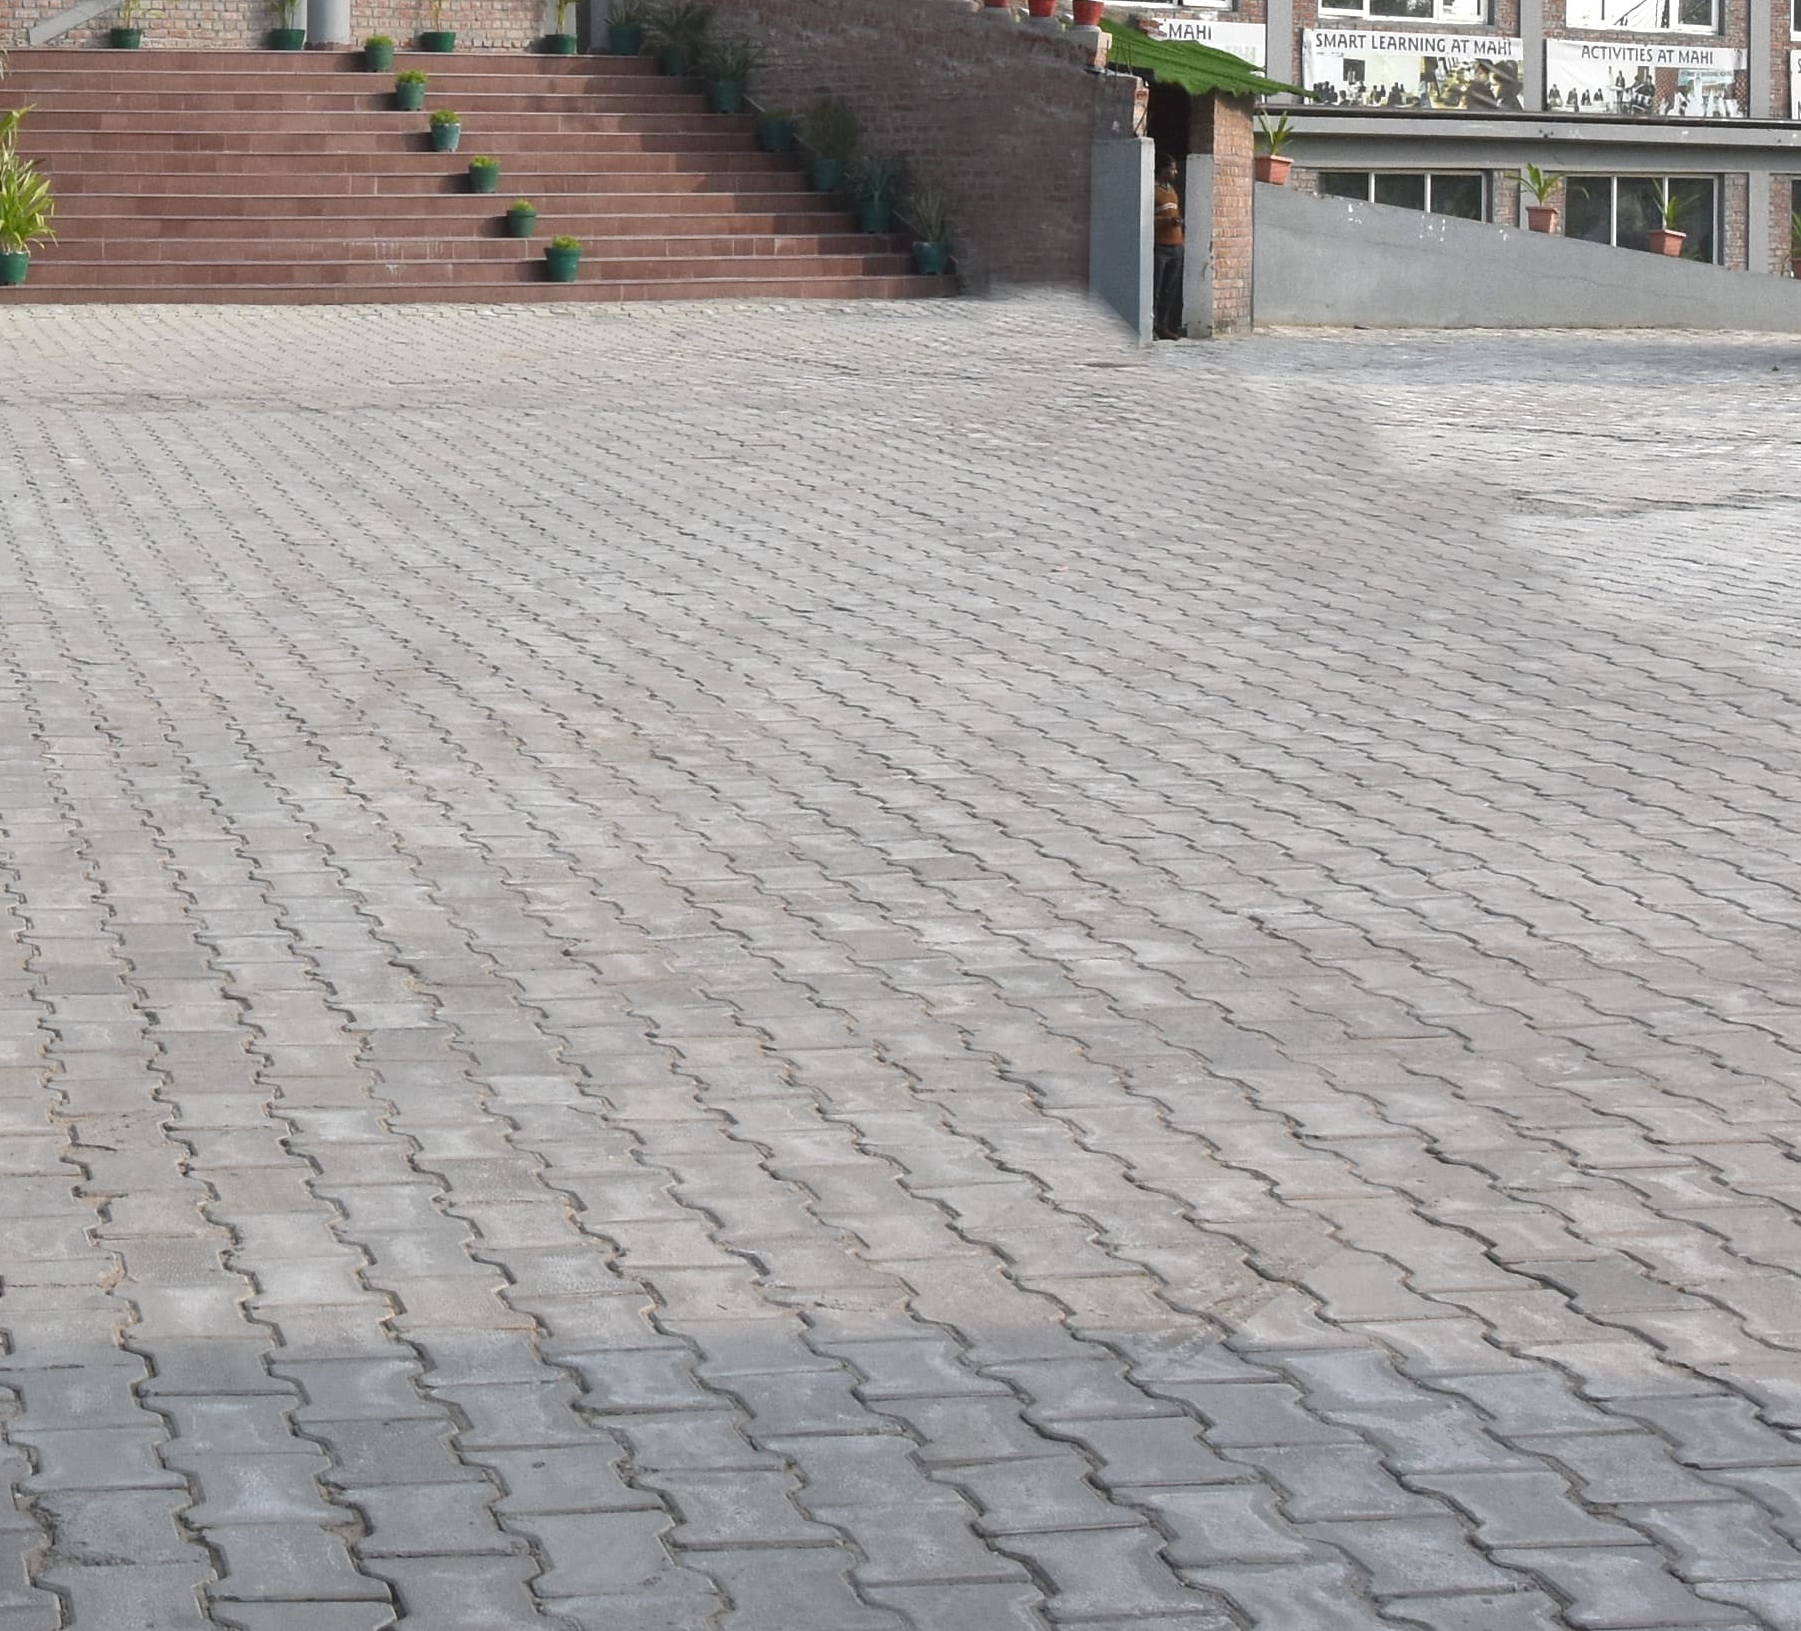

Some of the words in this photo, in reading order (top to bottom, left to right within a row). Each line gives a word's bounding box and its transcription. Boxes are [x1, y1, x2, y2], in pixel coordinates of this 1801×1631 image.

[1168, 23, 1212, 41] MAHI
[1315, 33, 1366, 49] SMART
[1371, 35, 1446, 53] LEARNING
[1451, 39, 1470, 53] AT
[1474, 40, 1512, 56] MAHI
[1581, 45, 1653, 63] ACTIVITIES
[1657, 49, 1675, 64] AT
[1678, 50, 1713, 65] MAHI
